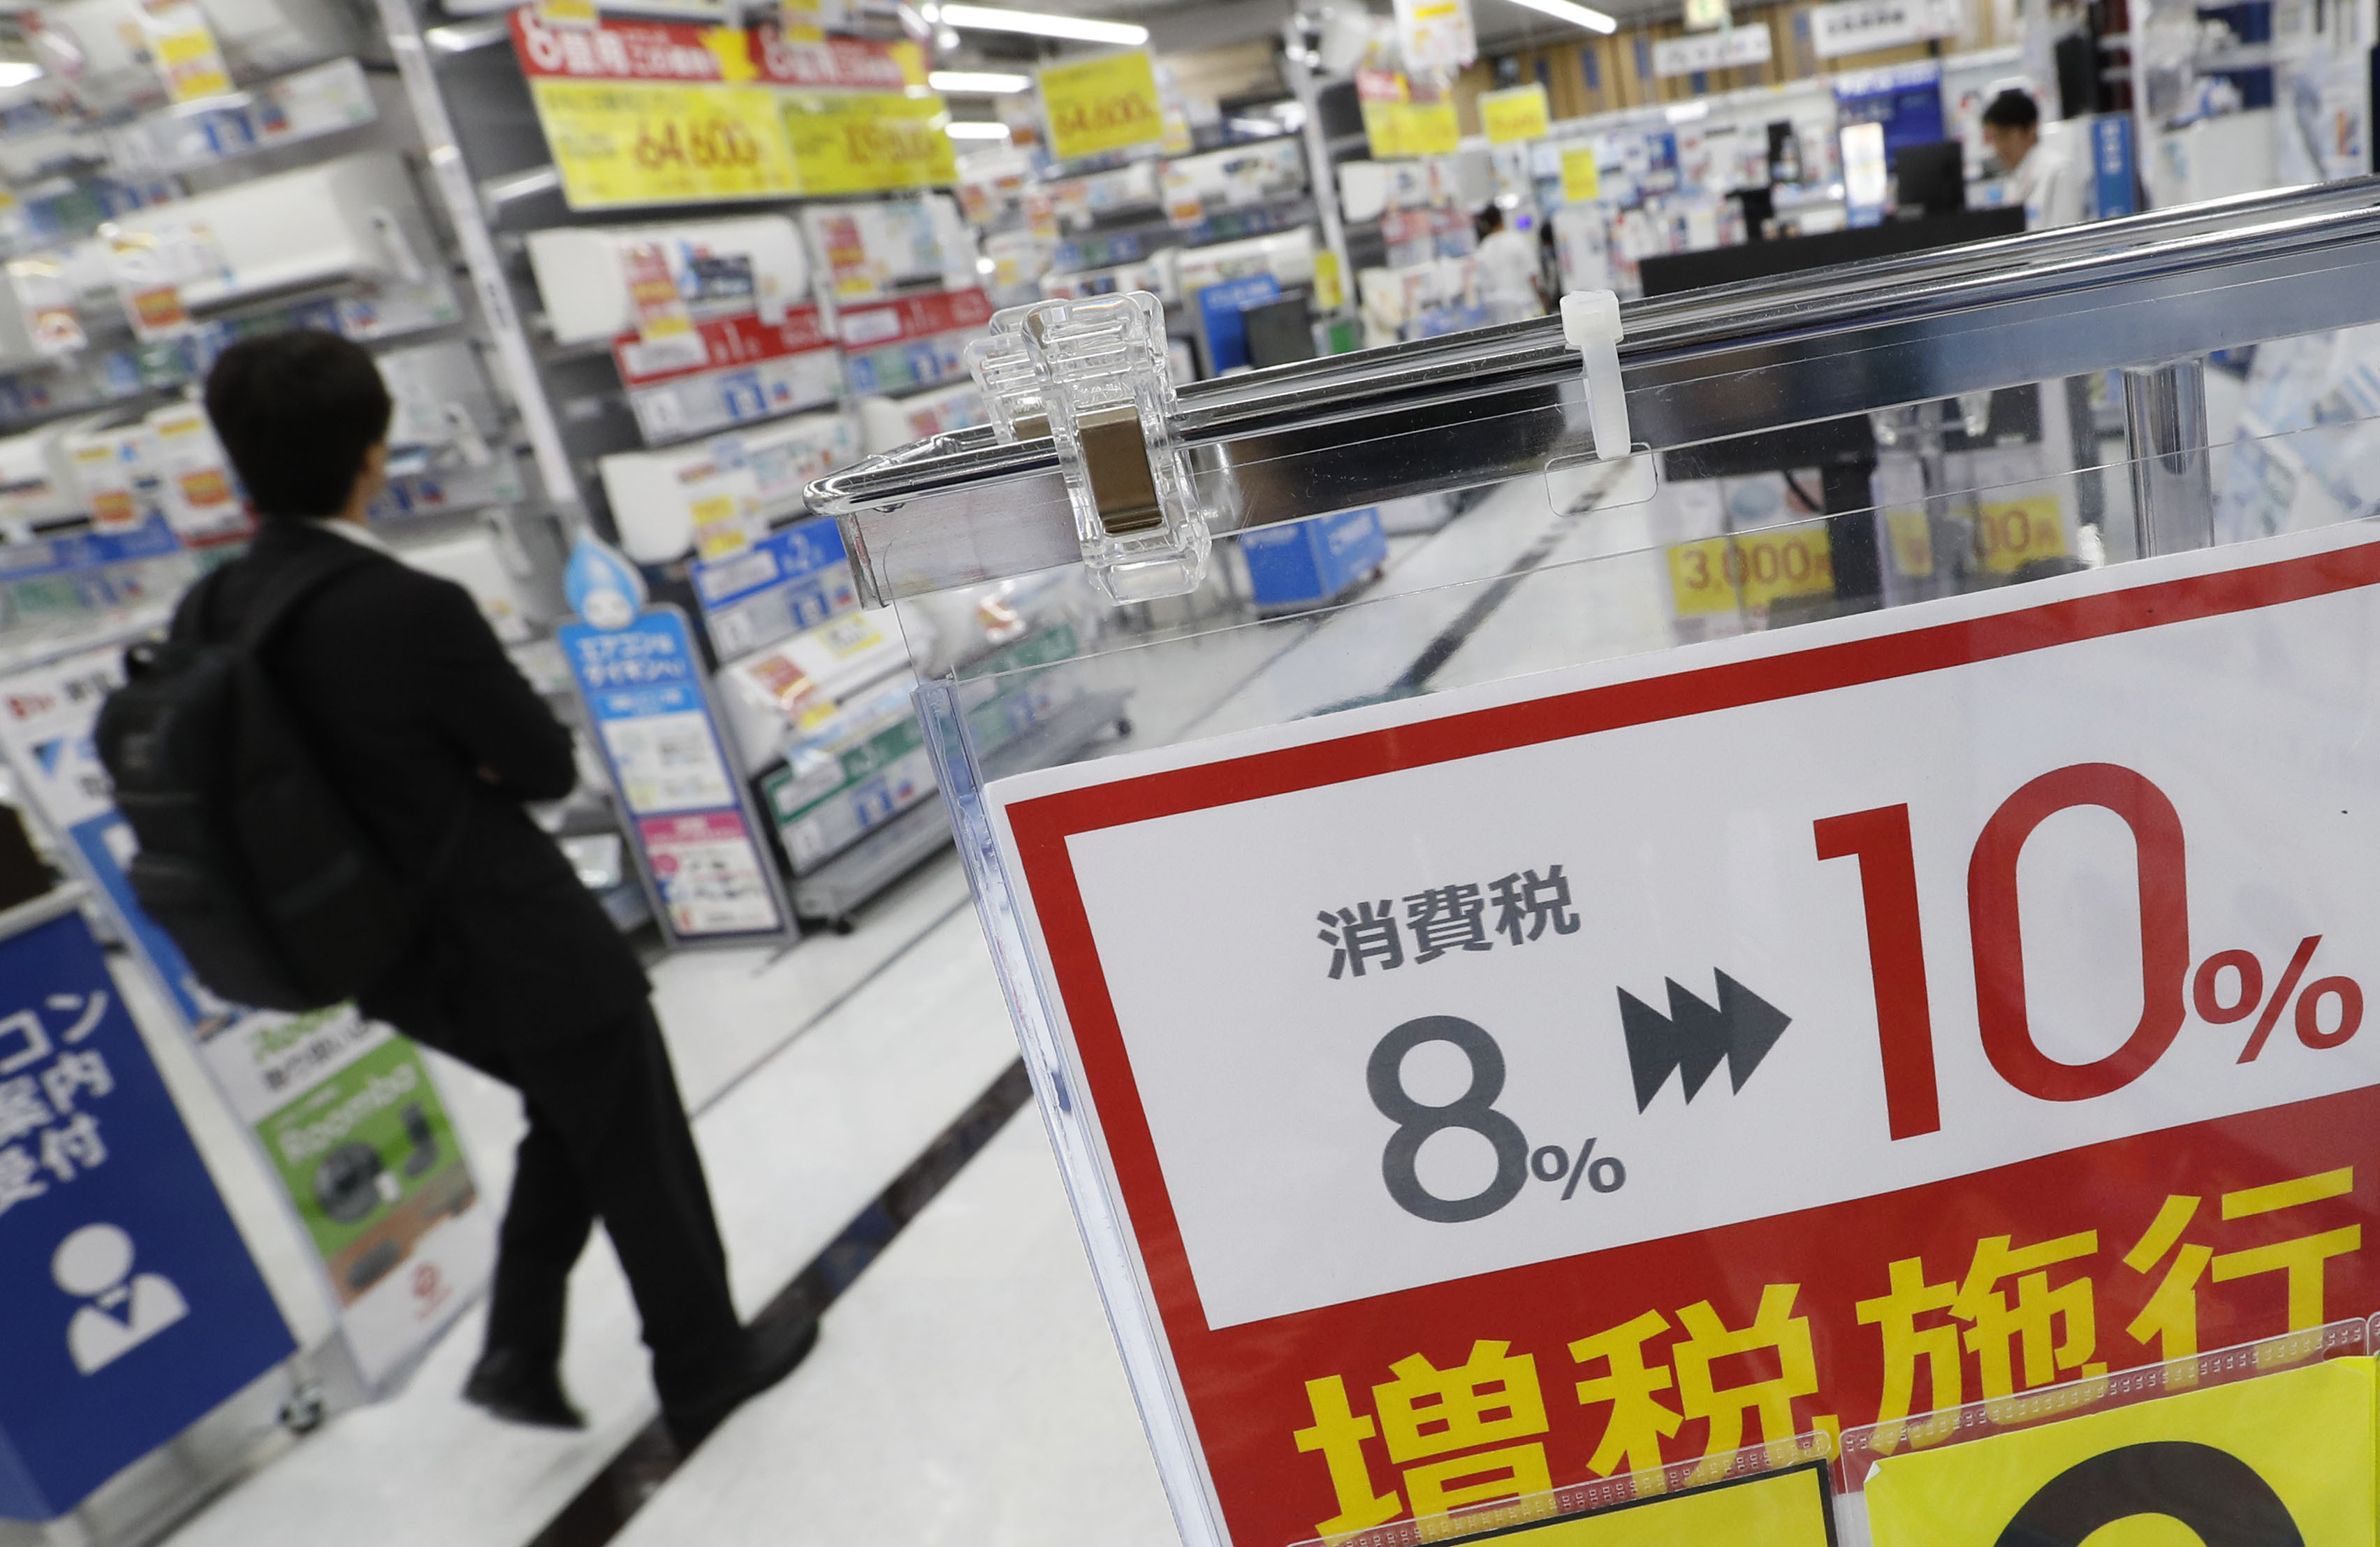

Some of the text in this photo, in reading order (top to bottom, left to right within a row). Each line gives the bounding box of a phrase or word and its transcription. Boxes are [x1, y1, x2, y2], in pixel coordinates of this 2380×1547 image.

[1316, 864, 1582, 980] 消費税
[1366, 762, 2364, 1223] 8% 10%
[1292, 1165, 2362, 1547] 増税施行
